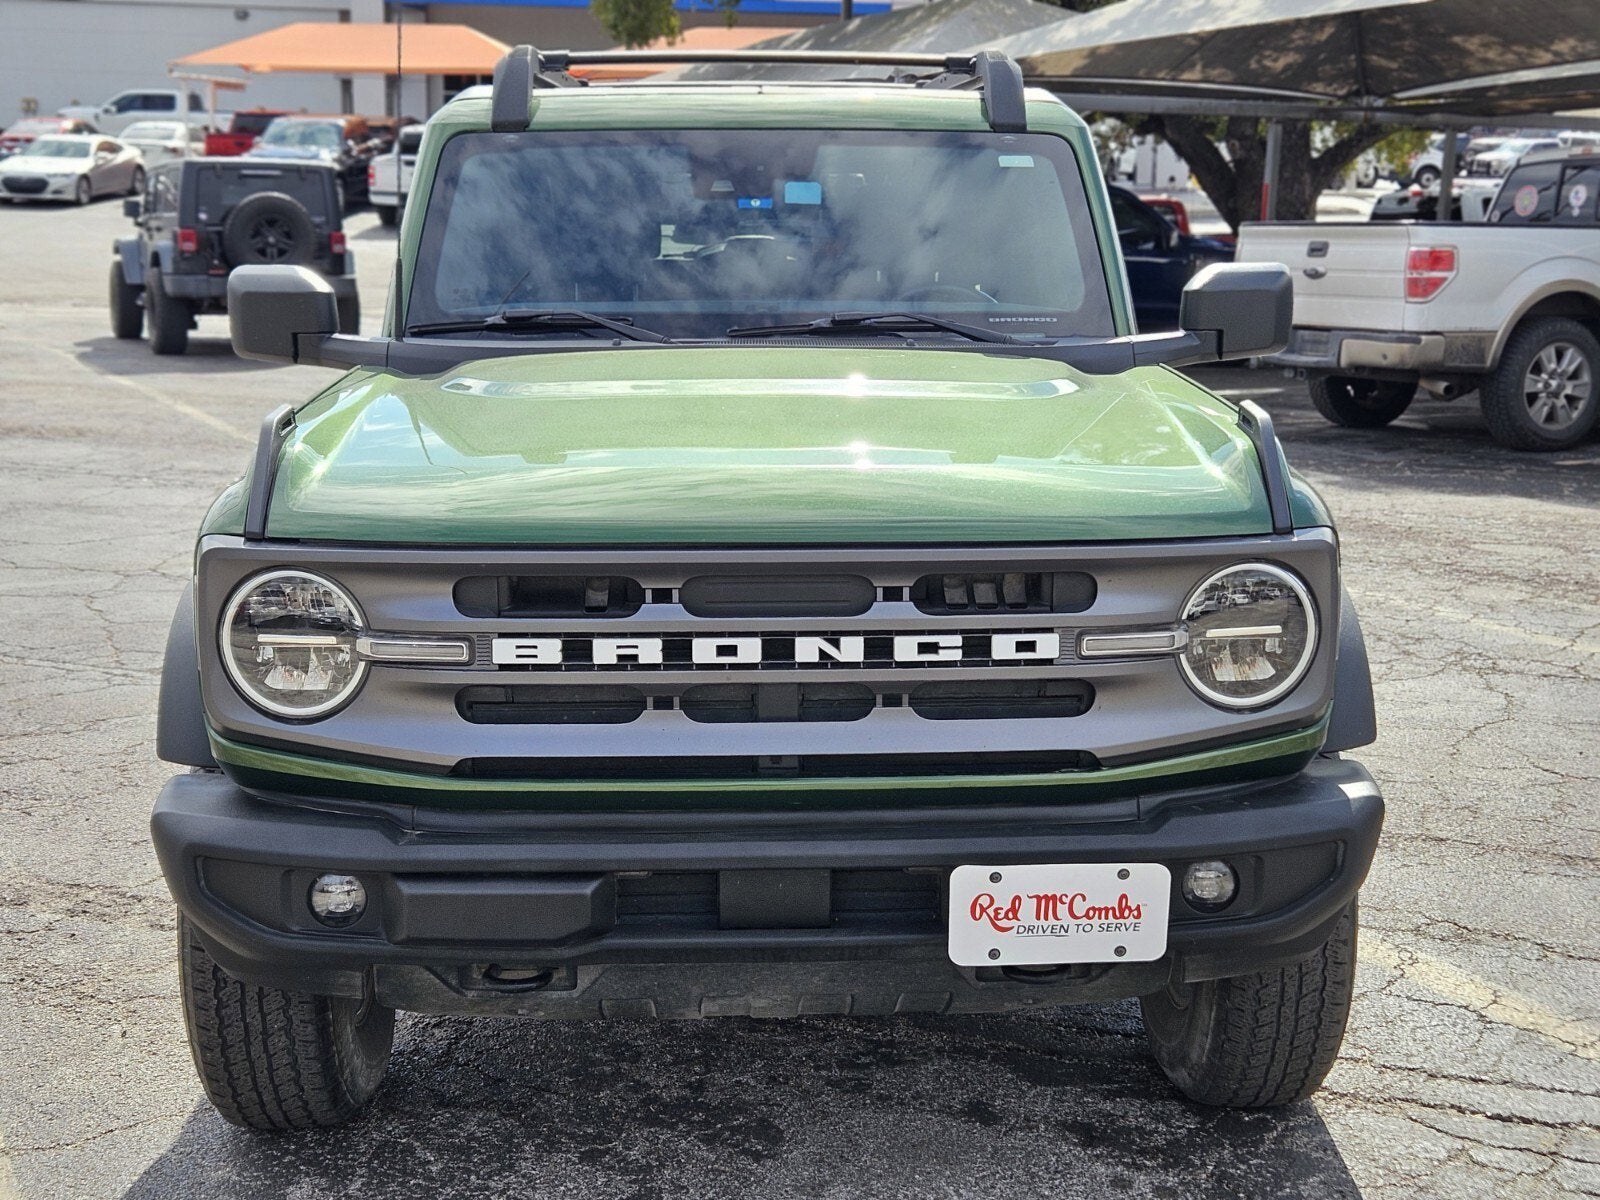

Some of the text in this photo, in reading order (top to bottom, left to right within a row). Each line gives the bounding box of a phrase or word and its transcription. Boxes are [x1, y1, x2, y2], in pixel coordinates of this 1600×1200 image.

[491, 632, 1061, 666] BRONCO
[969, 893, 1142, 933] Red McCombs
[1016, 921, 1142, 935] DRIVEN TO SERVE
